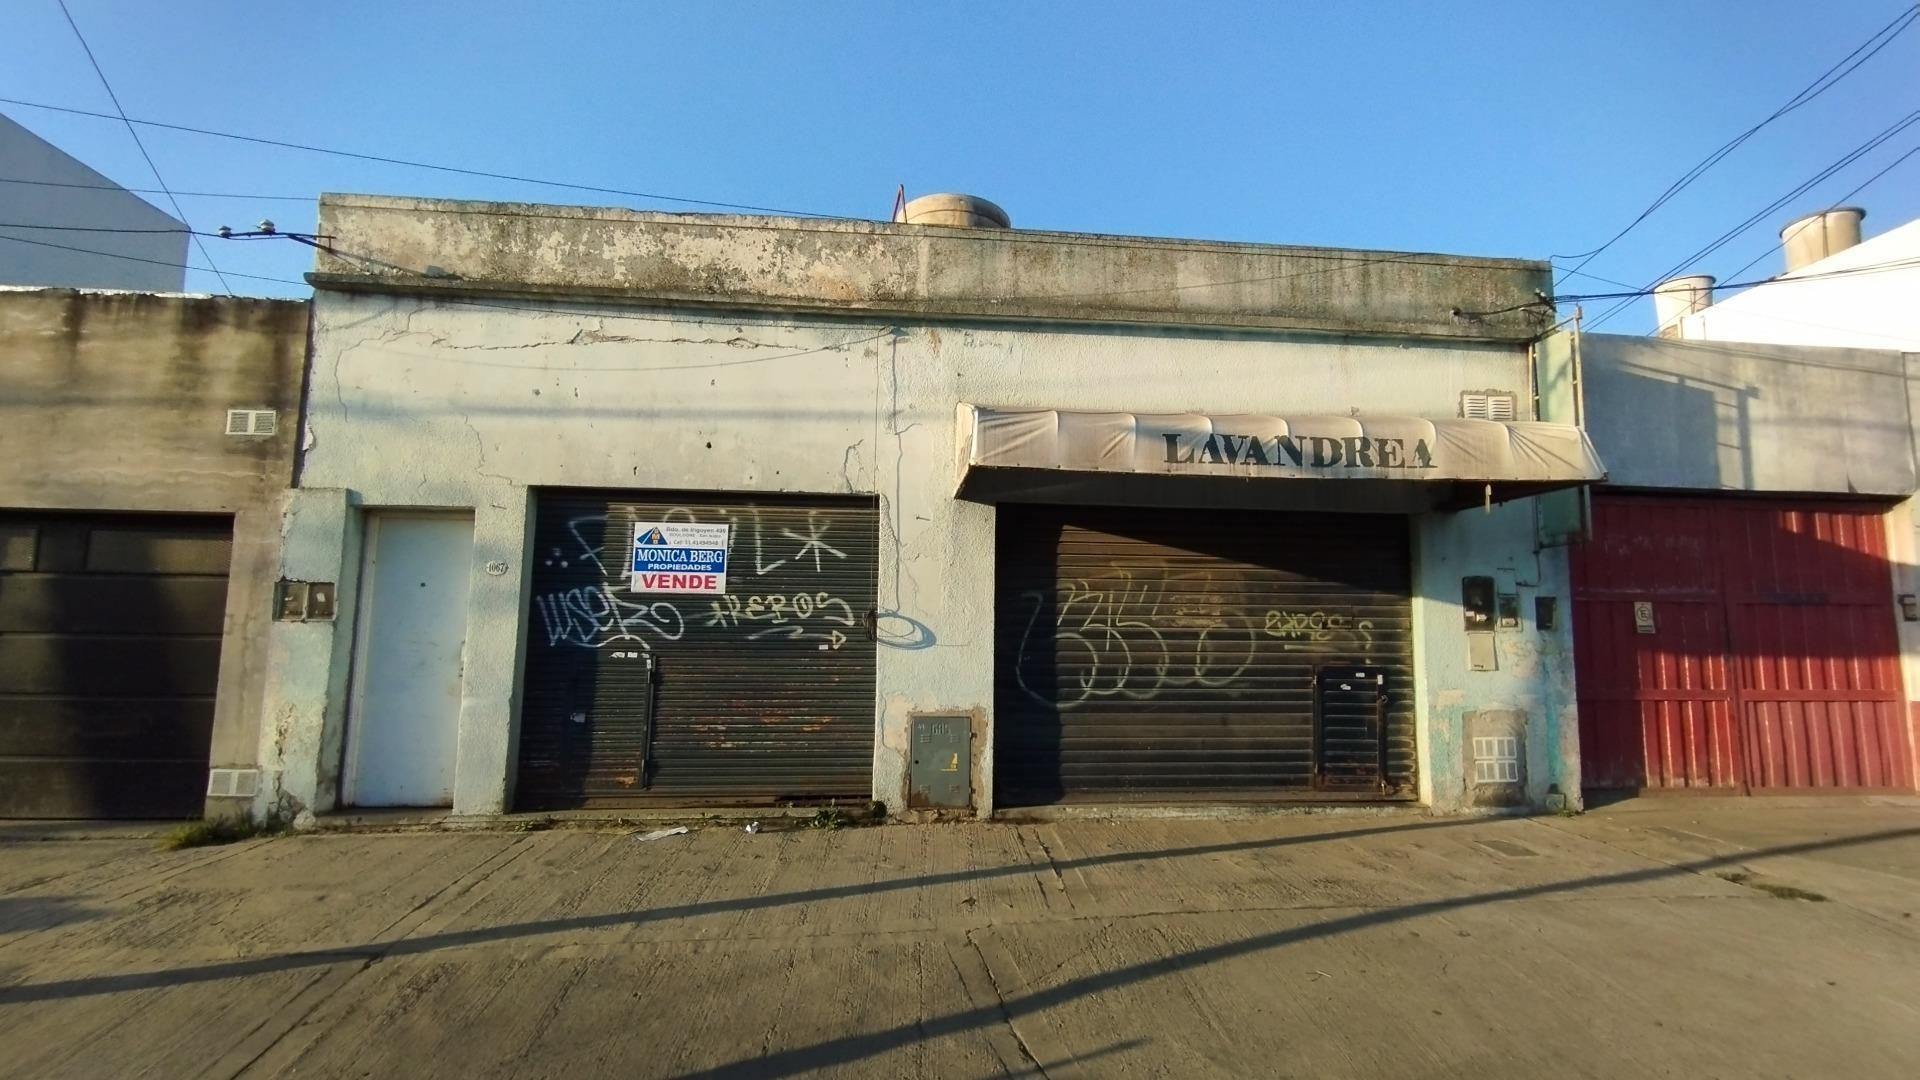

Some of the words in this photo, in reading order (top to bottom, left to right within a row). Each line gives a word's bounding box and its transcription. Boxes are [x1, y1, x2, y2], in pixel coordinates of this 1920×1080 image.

[1162, 433, 1438, 468] LAVANDREA
[637, 549, 687, 562] MONICA
[690, 550, 723, 563] BERG
[648, 563, 712, 571] PROPIEDADES
[642, 574, 717, 589] VENDE
